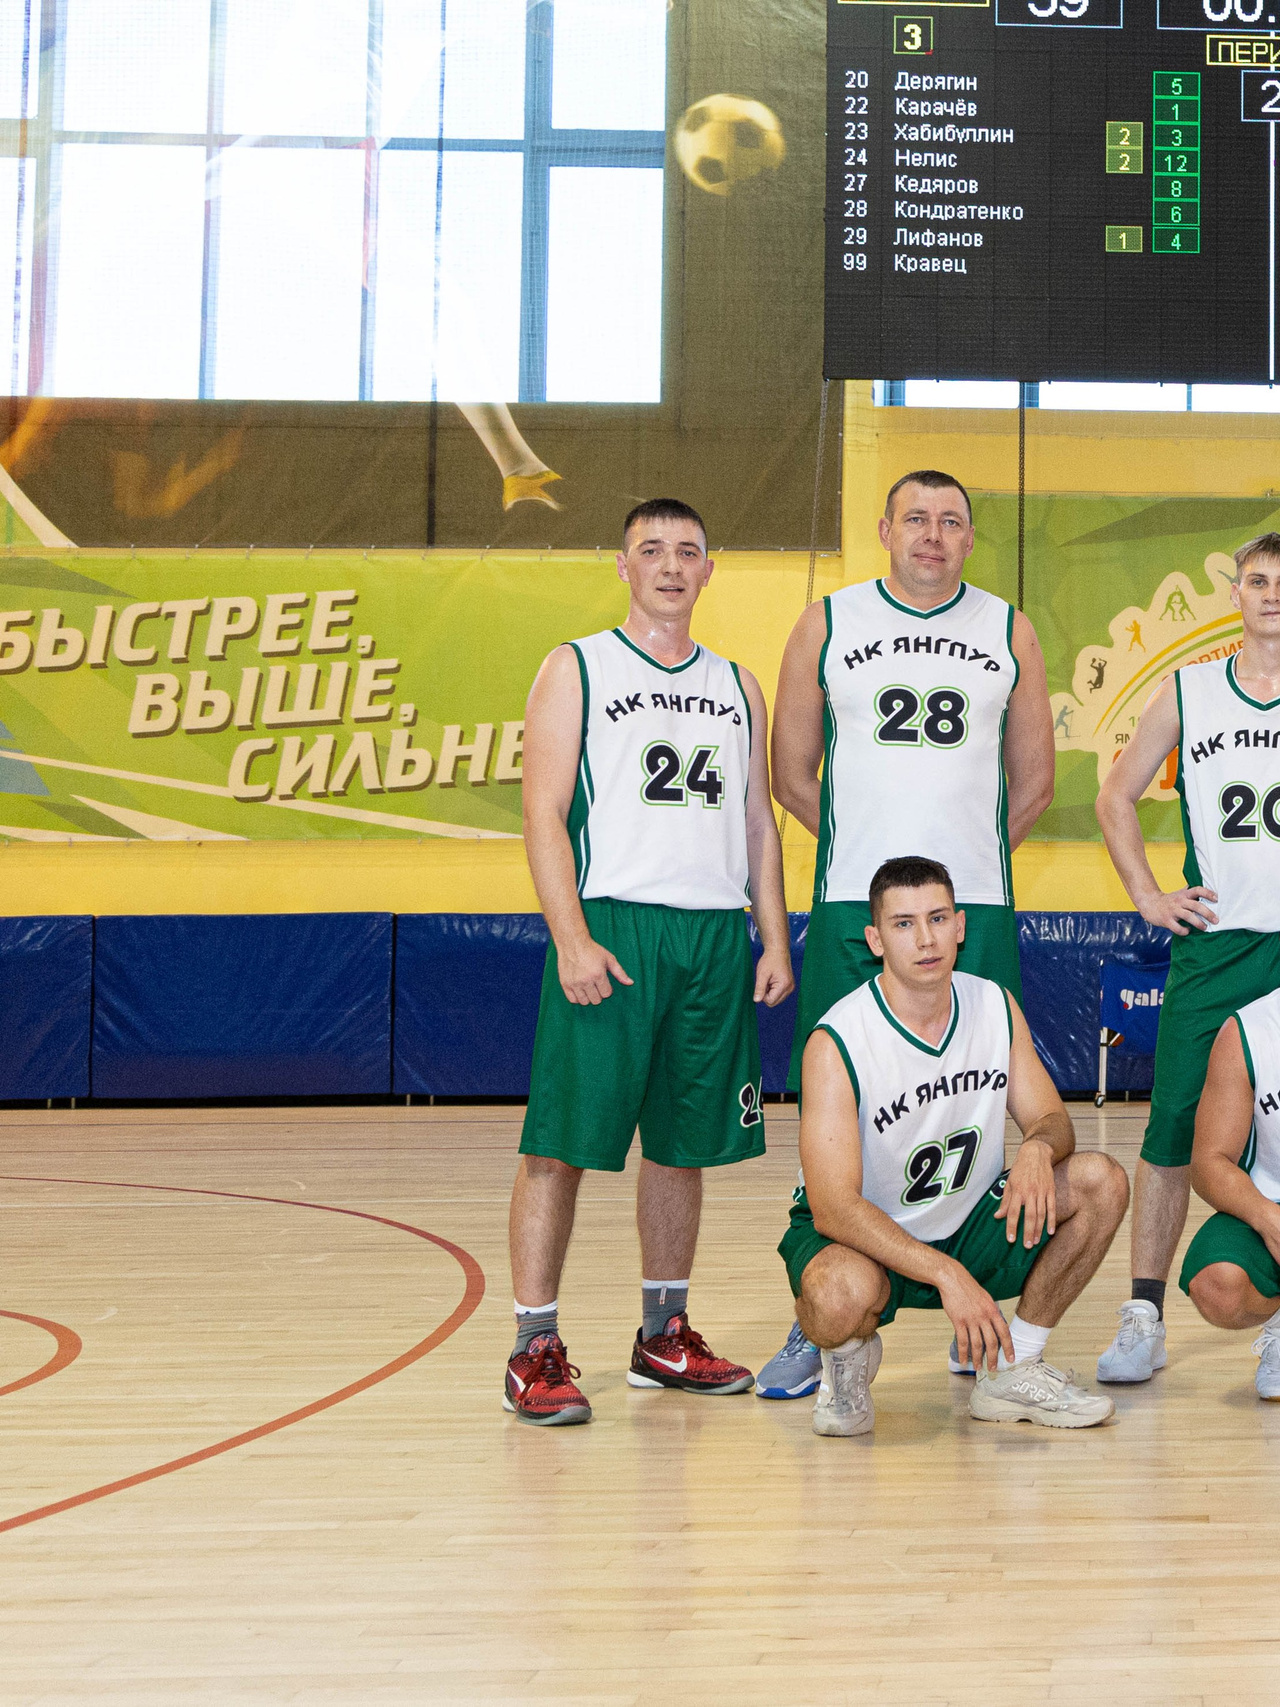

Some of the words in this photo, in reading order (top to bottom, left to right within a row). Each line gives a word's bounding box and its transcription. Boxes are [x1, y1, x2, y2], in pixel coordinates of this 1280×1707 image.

[903, 23, 922, 51] 3
[844, 70, 869, 89] 20
[894, 71, 978, 92] Дерягин
[1171, 78, 1182, 95] 5
[844, 95, 869, 115] 22
[895, 97, 977, 118] Карачёв
[1171, 103, 1179, 121] 1
[844, 121, 869, 141] 23
[893, 122, 1014, 144] Хабибуллин
[1119, 127, 1130, 145] 2
[1171, 129, 1182, 147] 3
[844, 147, 868, 166] 24
[895, 148, 958, 168] Нелис
[1119, 153, 1130, 171] 2
[1164, 154, 1187, 172] 12
[844, 173, 868, 192] 27
[894, 174, 979, 195] Кедяров
[1171, 180, 1182, 198] 8
[843, 199, 868, 218] 28
[894, 200, 1024, 221] Кондратенко
[1171, 206, 1182, 223] 6
[843, 226, 867, 245] 29
[892, 227, 983, 248] Лифанов
[1119, 232, 1126, 250] 1
[1171, 233, 1182, 251] 4
[843, 252, 867, 271] 99
[894, 253, 967, 275] Кравец
[849, 640, 882, 670] НК
[893, 636, 1001, 672] ЯНГПУР
[128, 658, 418, 738] ВЫШЕ,
[605, 693, 644, 723] НК
[874, 684, 970, 749] 28
[1191, 732, 1225, 764] НК
[641, 740, 725, 810] 24
[873, 1092, 910, 1134] НК
[915, 1069, 1009, 1110] ЯНГПУР
[901, 1124, 983, 1207] 27
